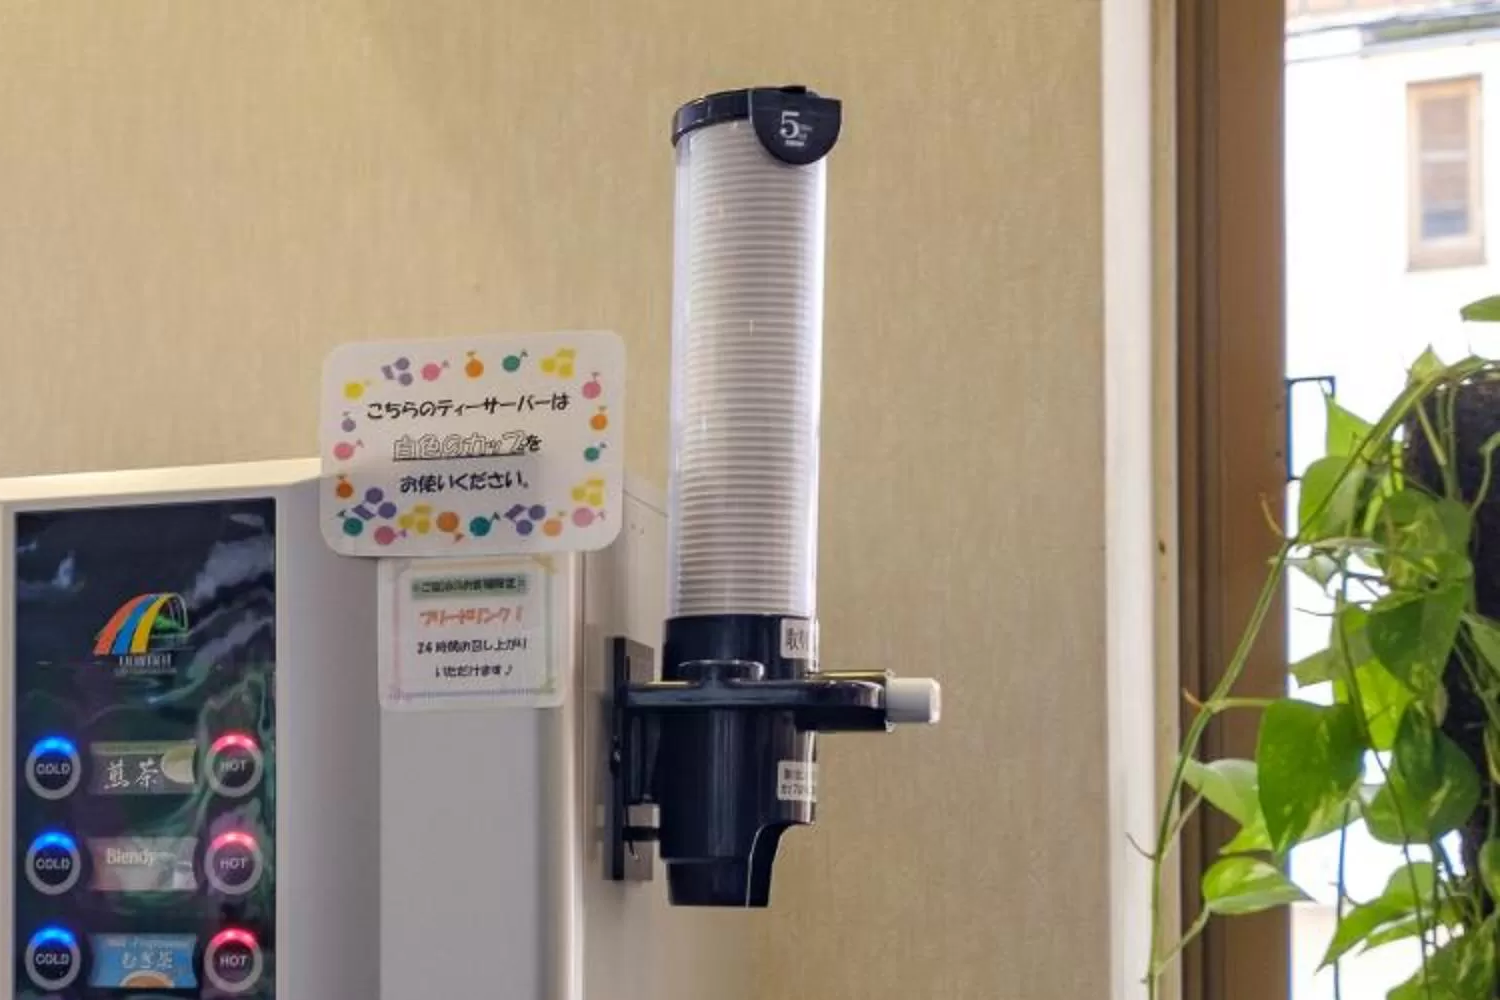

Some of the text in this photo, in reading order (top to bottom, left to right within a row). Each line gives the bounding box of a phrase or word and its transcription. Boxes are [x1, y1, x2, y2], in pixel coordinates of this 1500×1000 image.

[780, 111, 800, 139] 5
[366, 393, 571, 420] こちらのティーサーバーは
[393, 429, 543, 460] 白色のカップを
[399, 469, 530, 494] お使いください。
[36, 763, 71, 775] COLD
[220, 760, 247, 772] HOT
[36, 858, 71, 870] COLD
[106, 848, 156, 866] Blendy
[220, 857, 247, 869] HOT
[35, 953, 69, 965] COLD
[122, 949, 173, 969] むぎ茶
[219, 955, 247, 967] HOT
